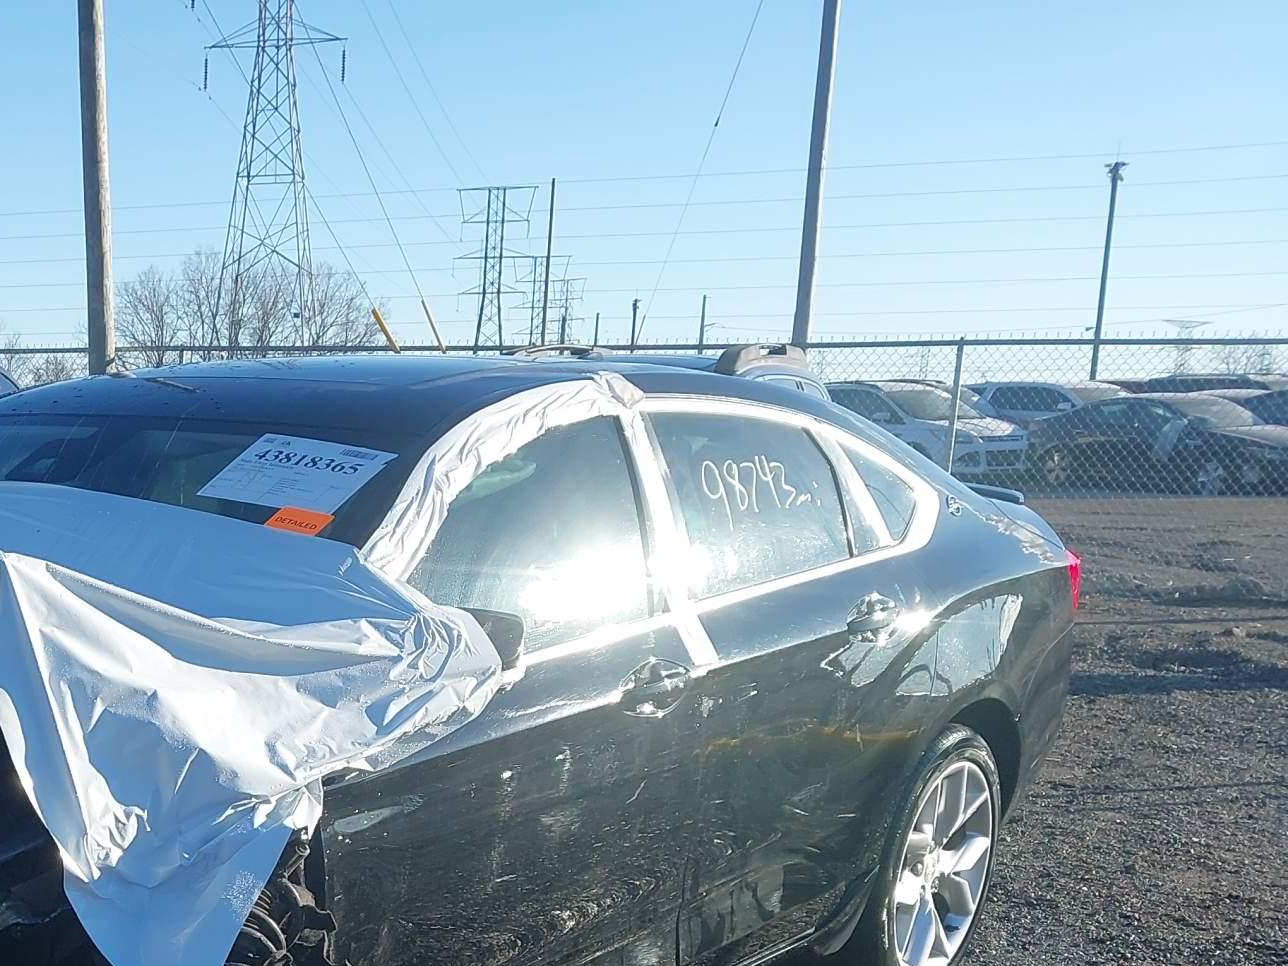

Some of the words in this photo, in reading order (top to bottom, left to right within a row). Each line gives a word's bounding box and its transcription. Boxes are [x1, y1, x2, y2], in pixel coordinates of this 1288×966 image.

[255, 448, 364, 475] 43818365
[701, 455, 797, 532] 98743
[275, 516, 318, 530] DETAILED
